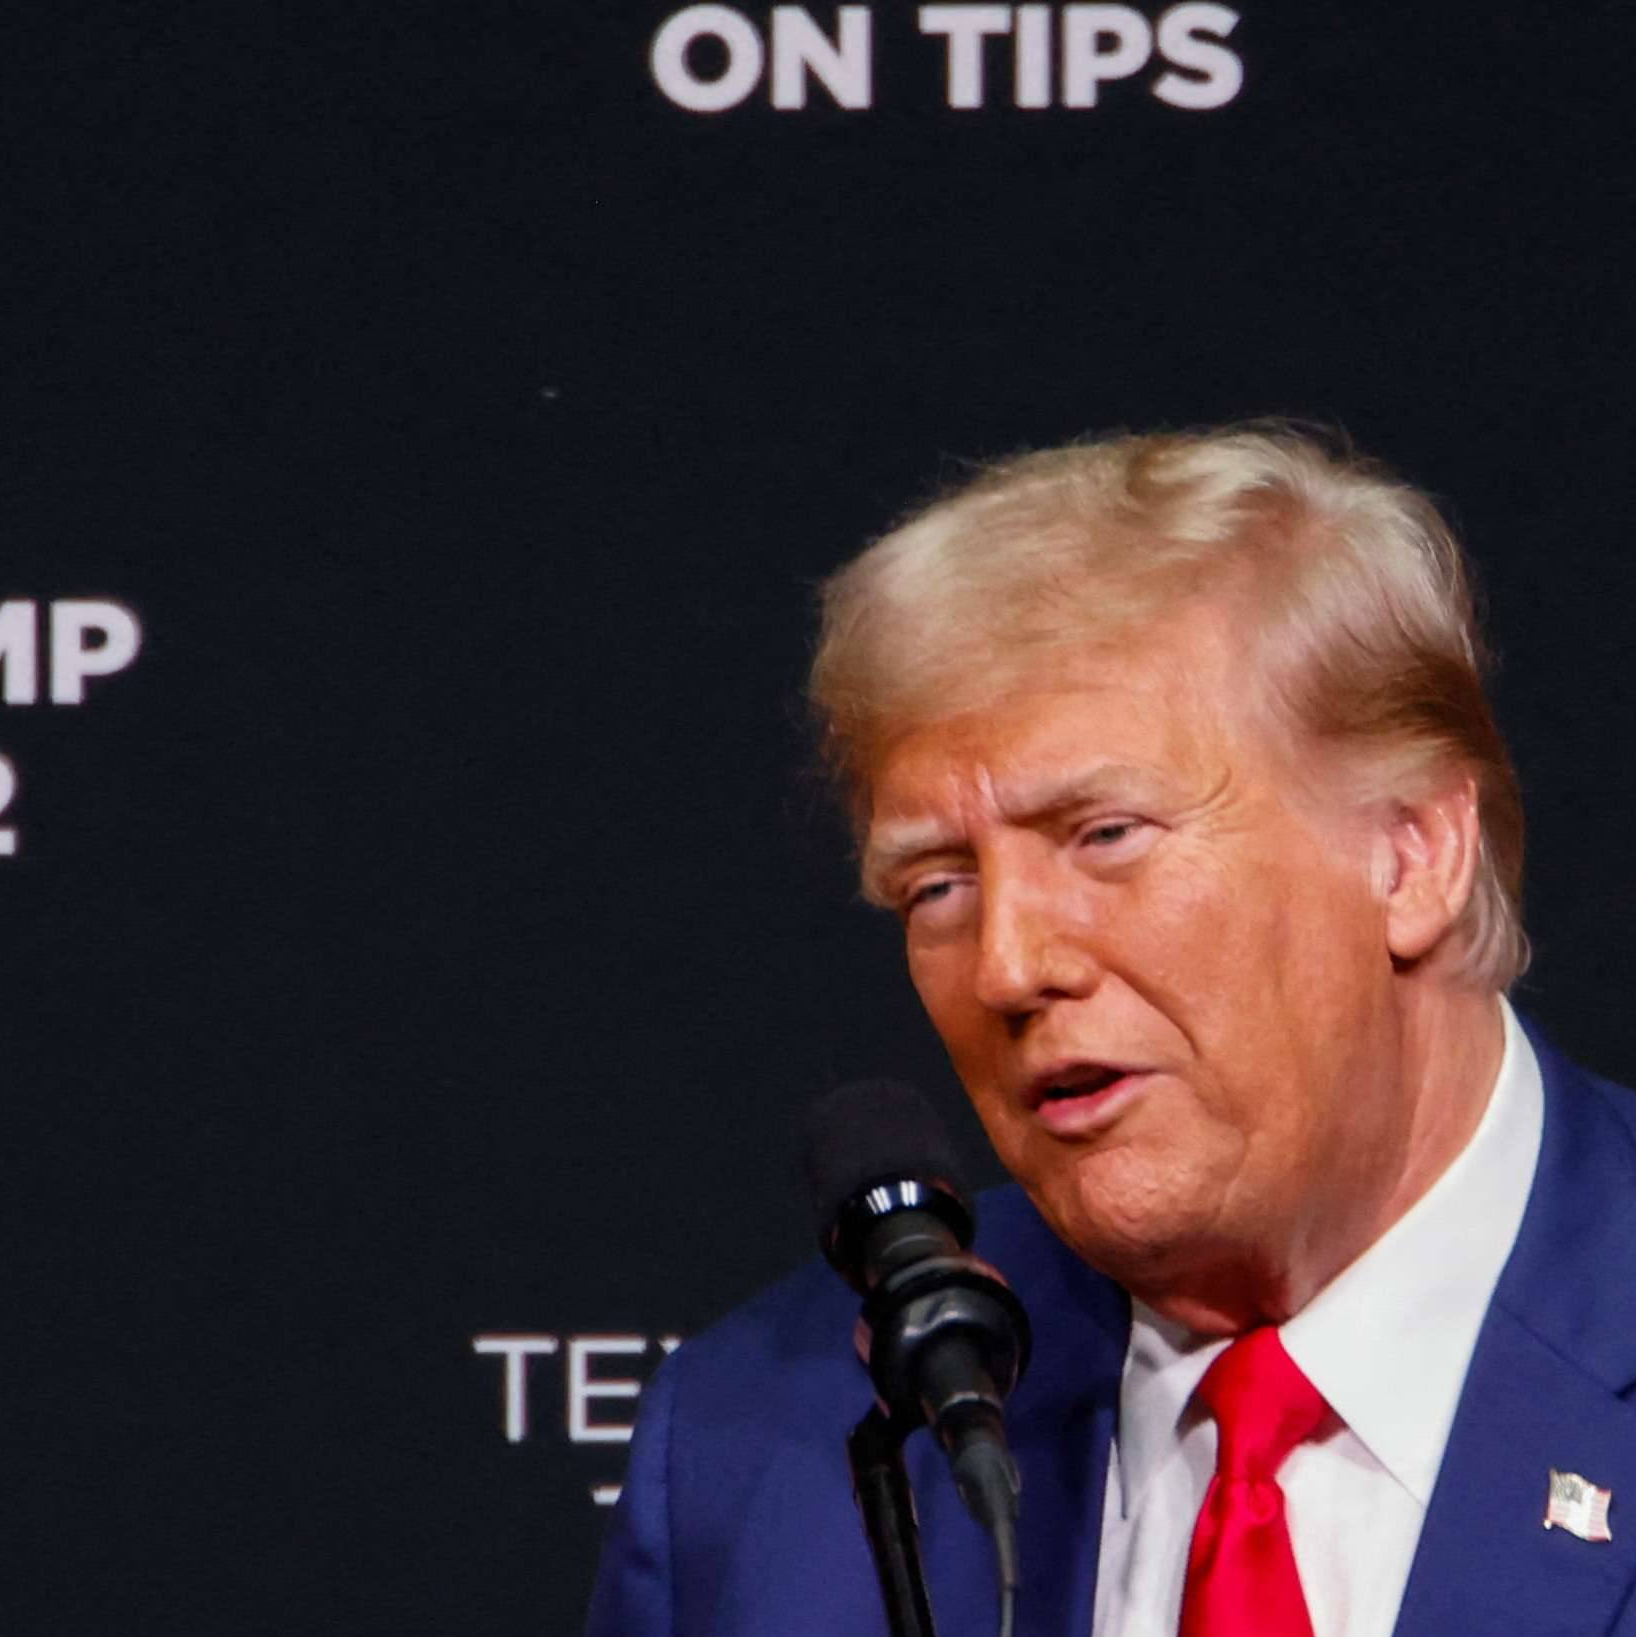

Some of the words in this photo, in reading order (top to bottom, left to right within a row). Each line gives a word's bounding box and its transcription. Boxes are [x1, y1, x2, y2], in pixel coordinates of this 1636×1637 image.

[650, 1, 873, 114] ON
[917, 0, 1245, 111] TIPS
[472, 1336, 684, 1444] TE
